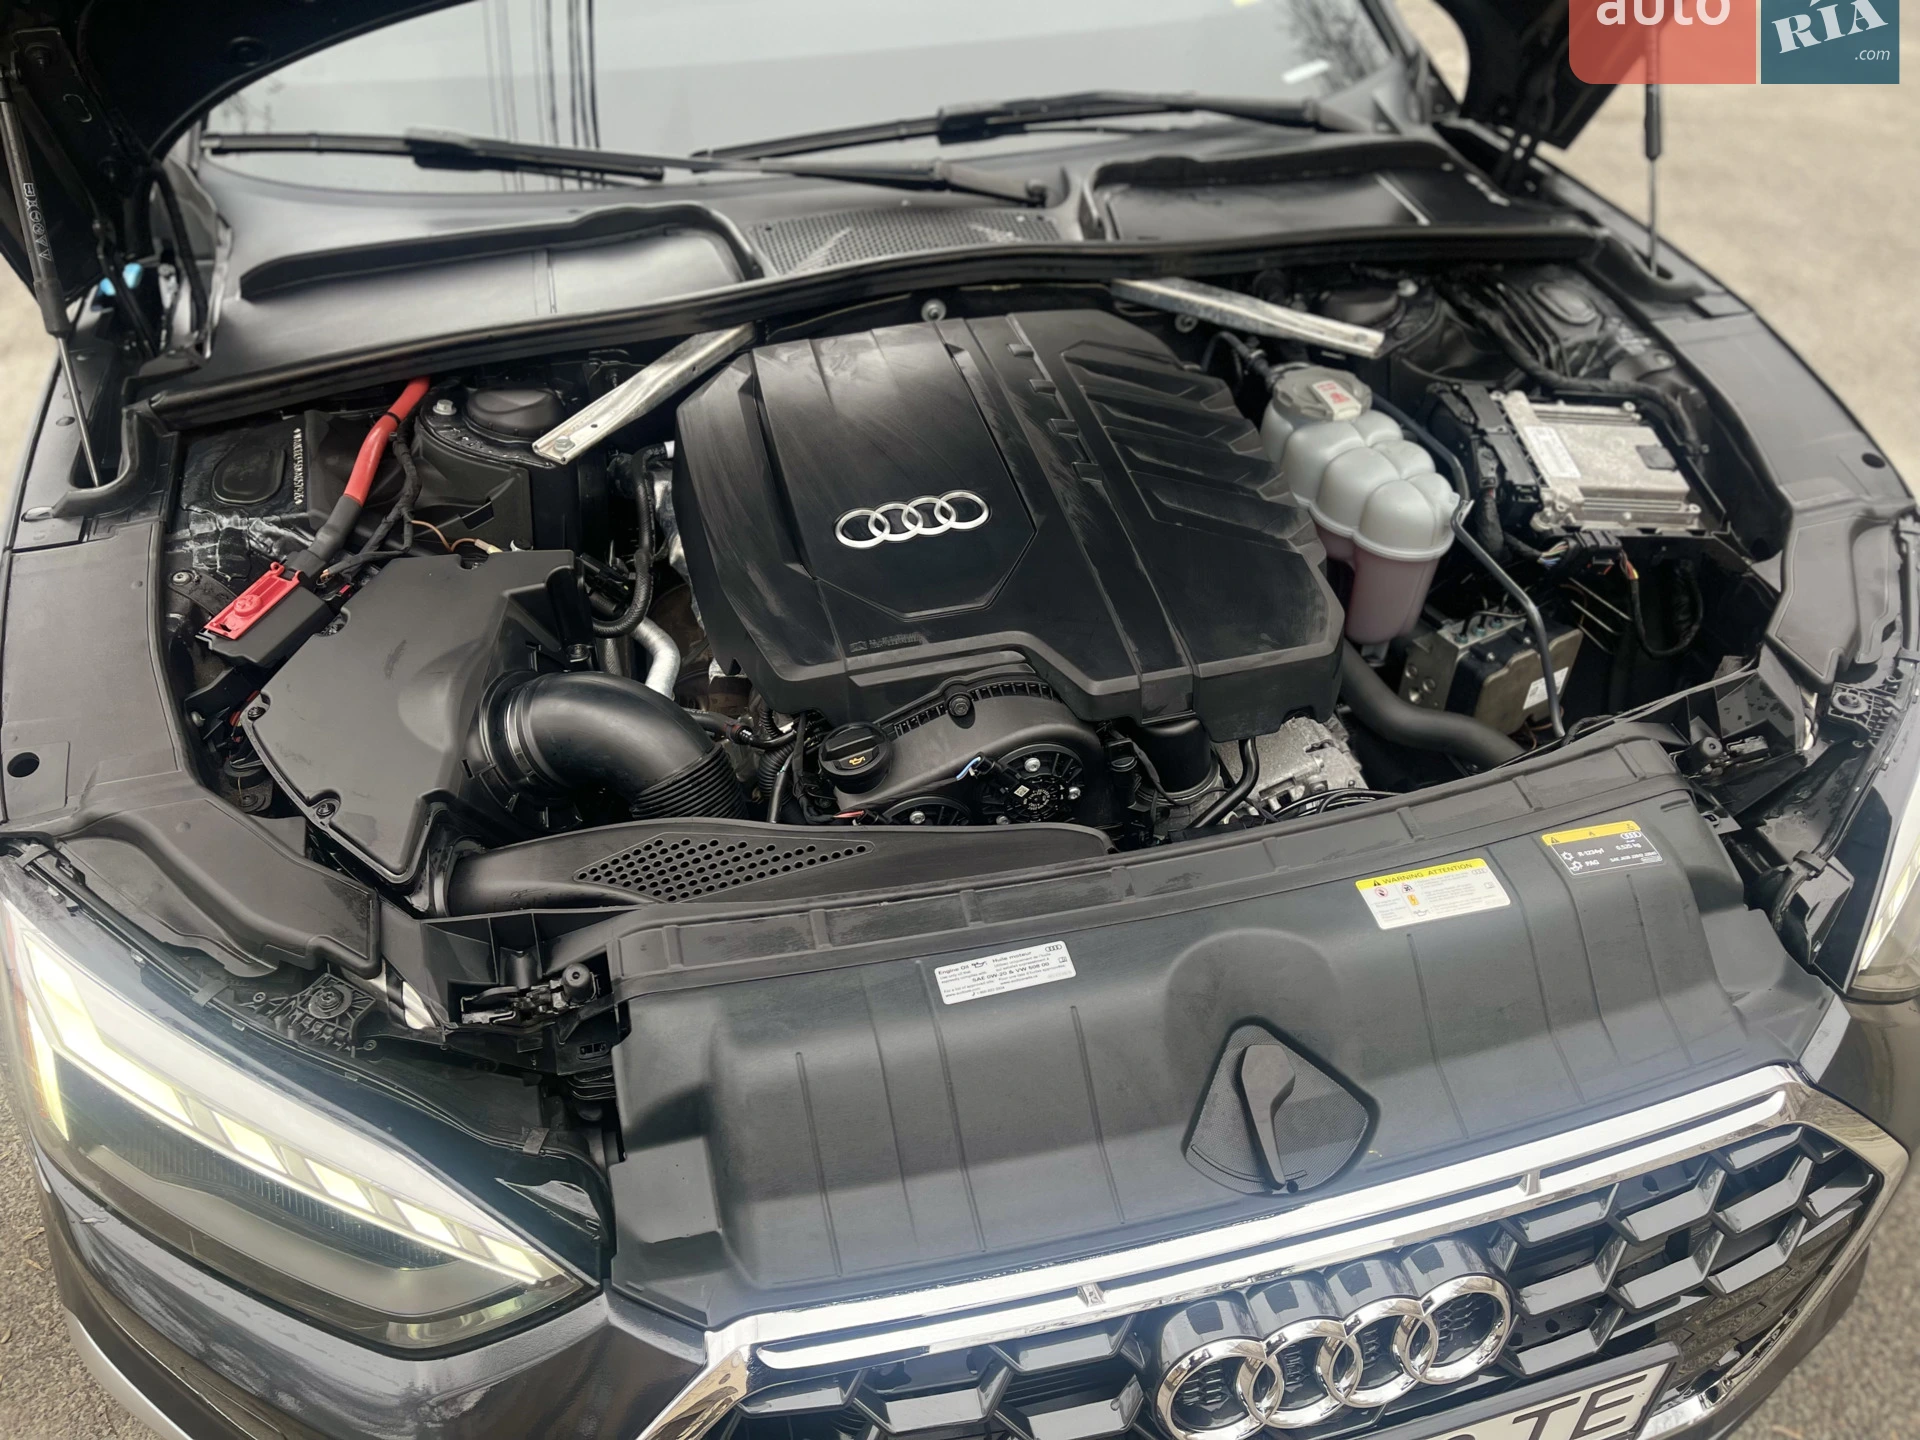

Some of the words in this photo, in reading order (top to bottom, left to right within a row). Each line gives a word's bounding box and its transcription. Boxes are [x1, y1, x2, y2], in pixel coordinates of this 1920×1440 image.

[1382, 872, 1424, 885] WARNING
[1427, 863, 1473, 876] ATTENTION
[1009, 951, 1032, 959] moteur
